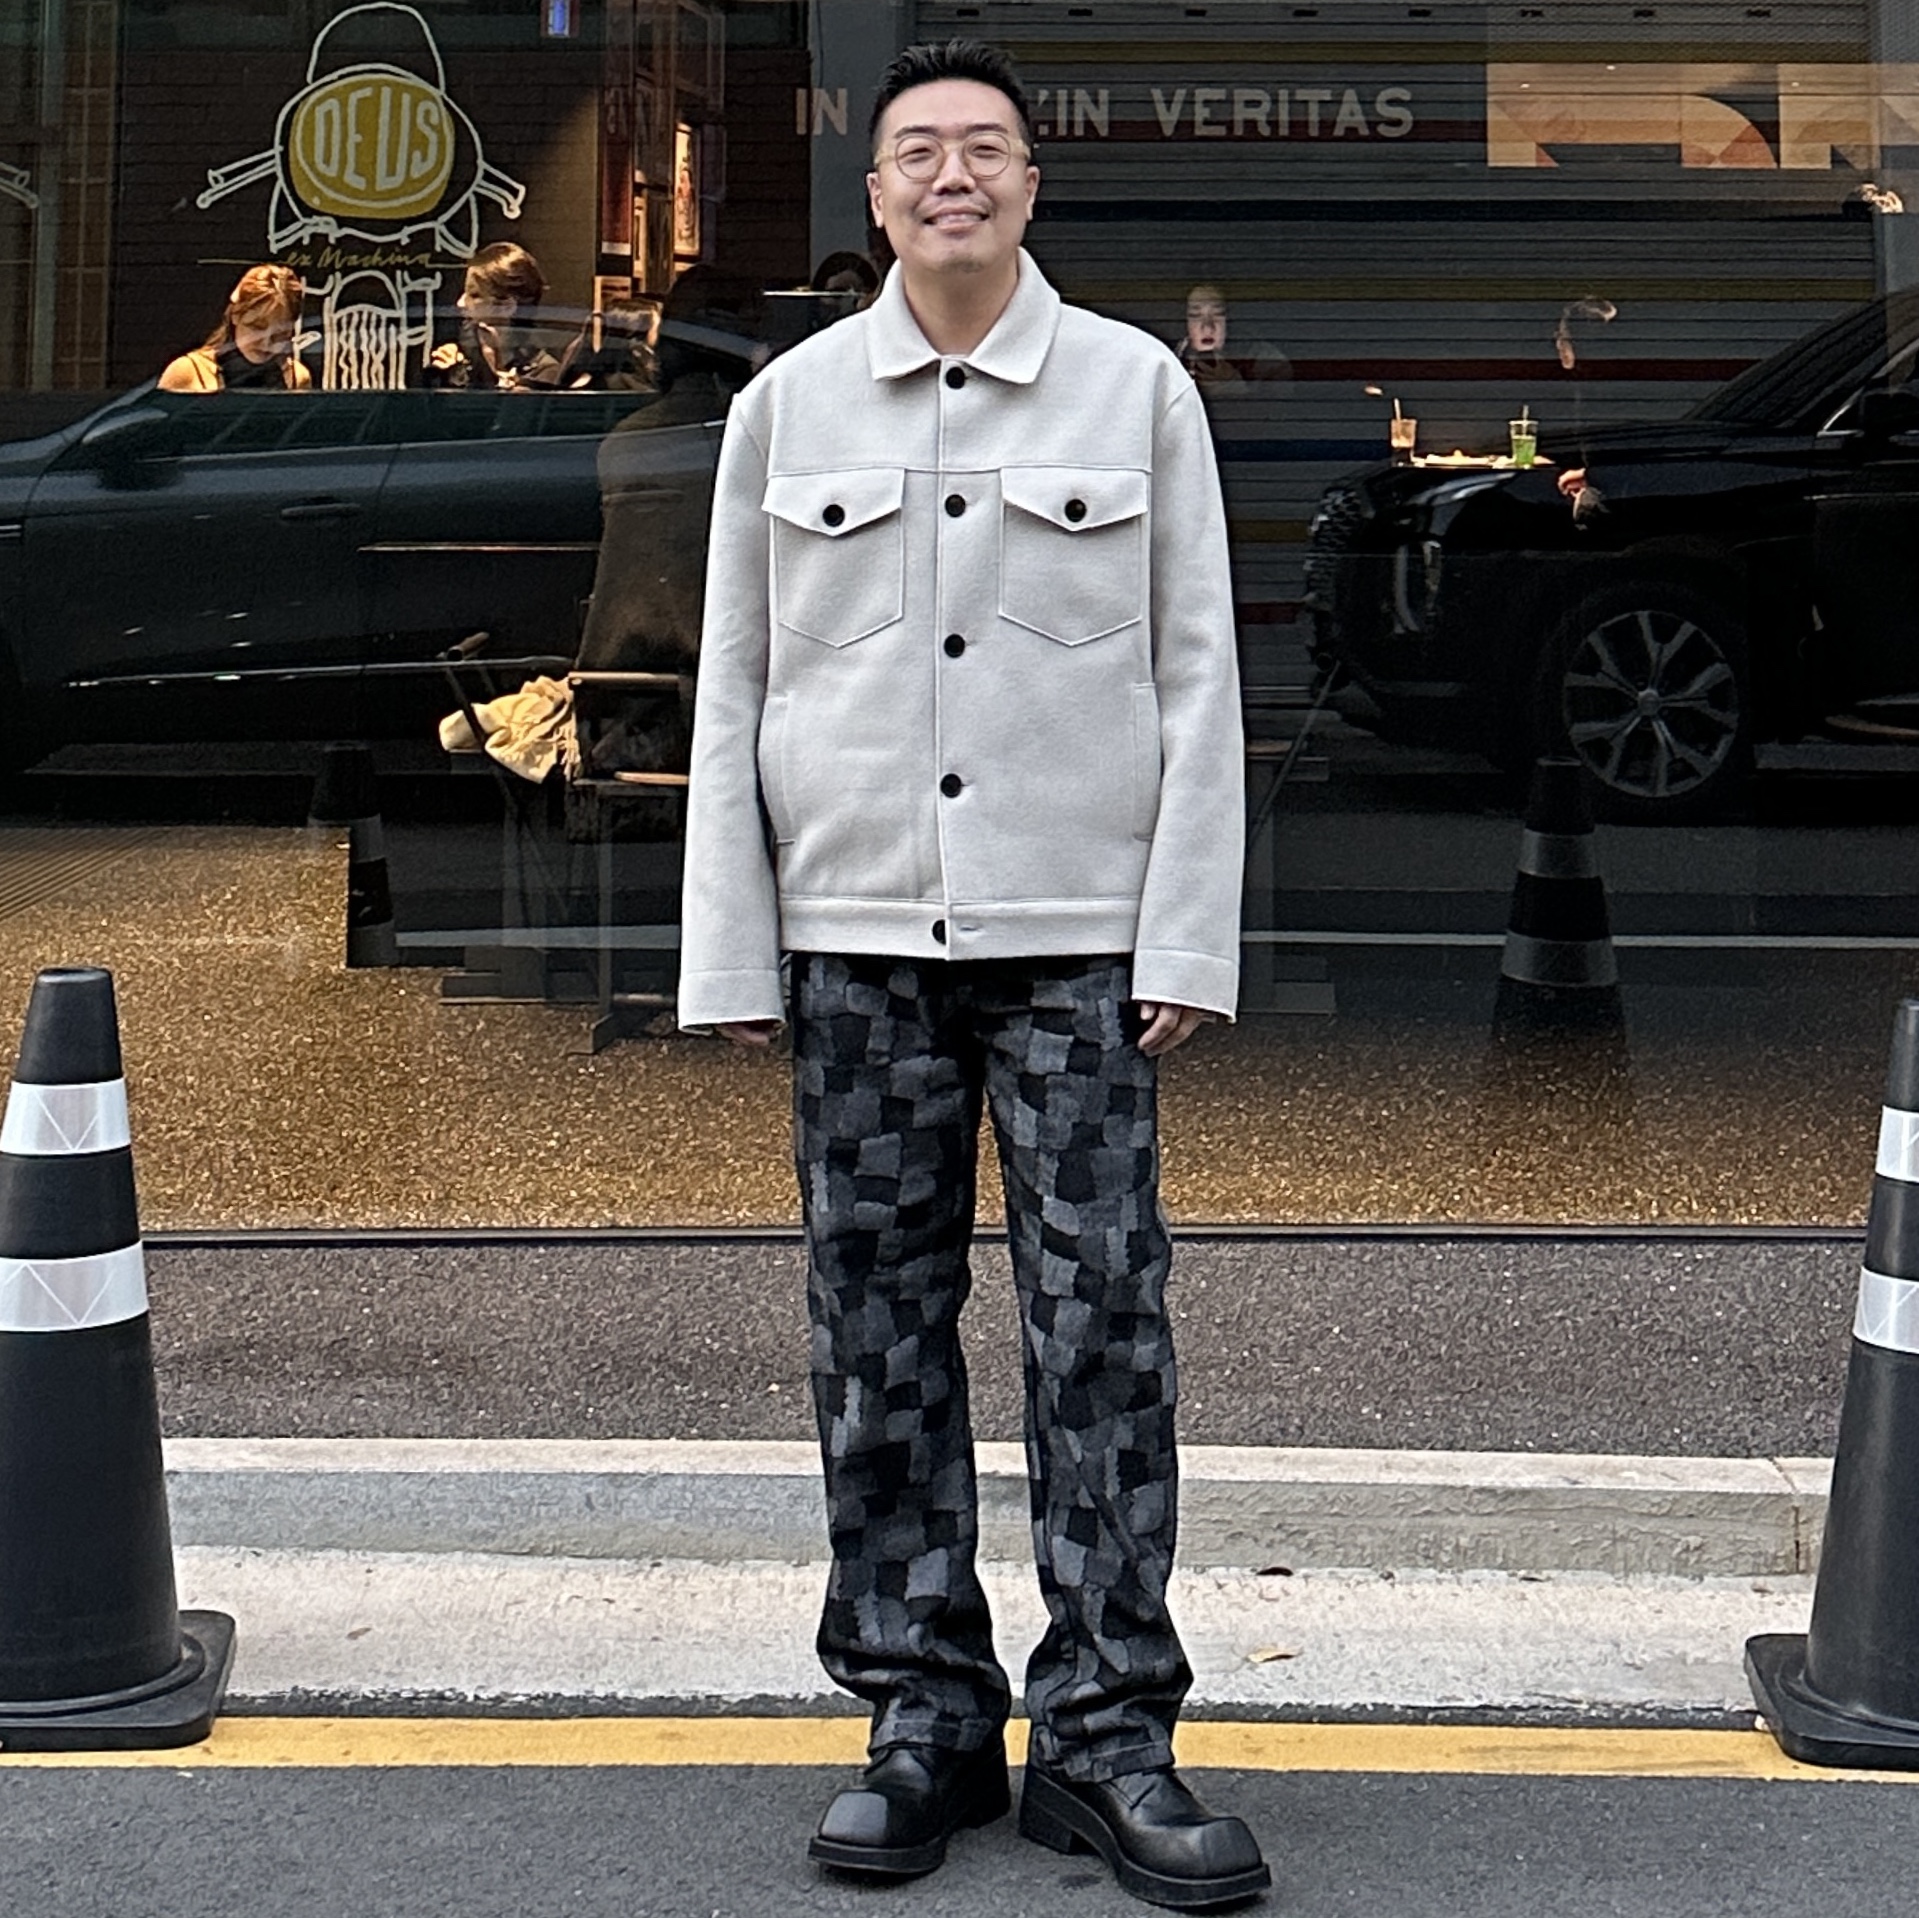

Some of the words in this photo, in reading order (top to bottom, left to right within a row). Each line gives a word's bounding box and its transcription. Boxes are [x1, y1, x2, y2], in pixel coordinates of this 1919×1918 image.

[314, 86, 440, 191] DEUS
[796, 88, 848, 136] IN
[1151, 87, 1414, 138] VERITAS
